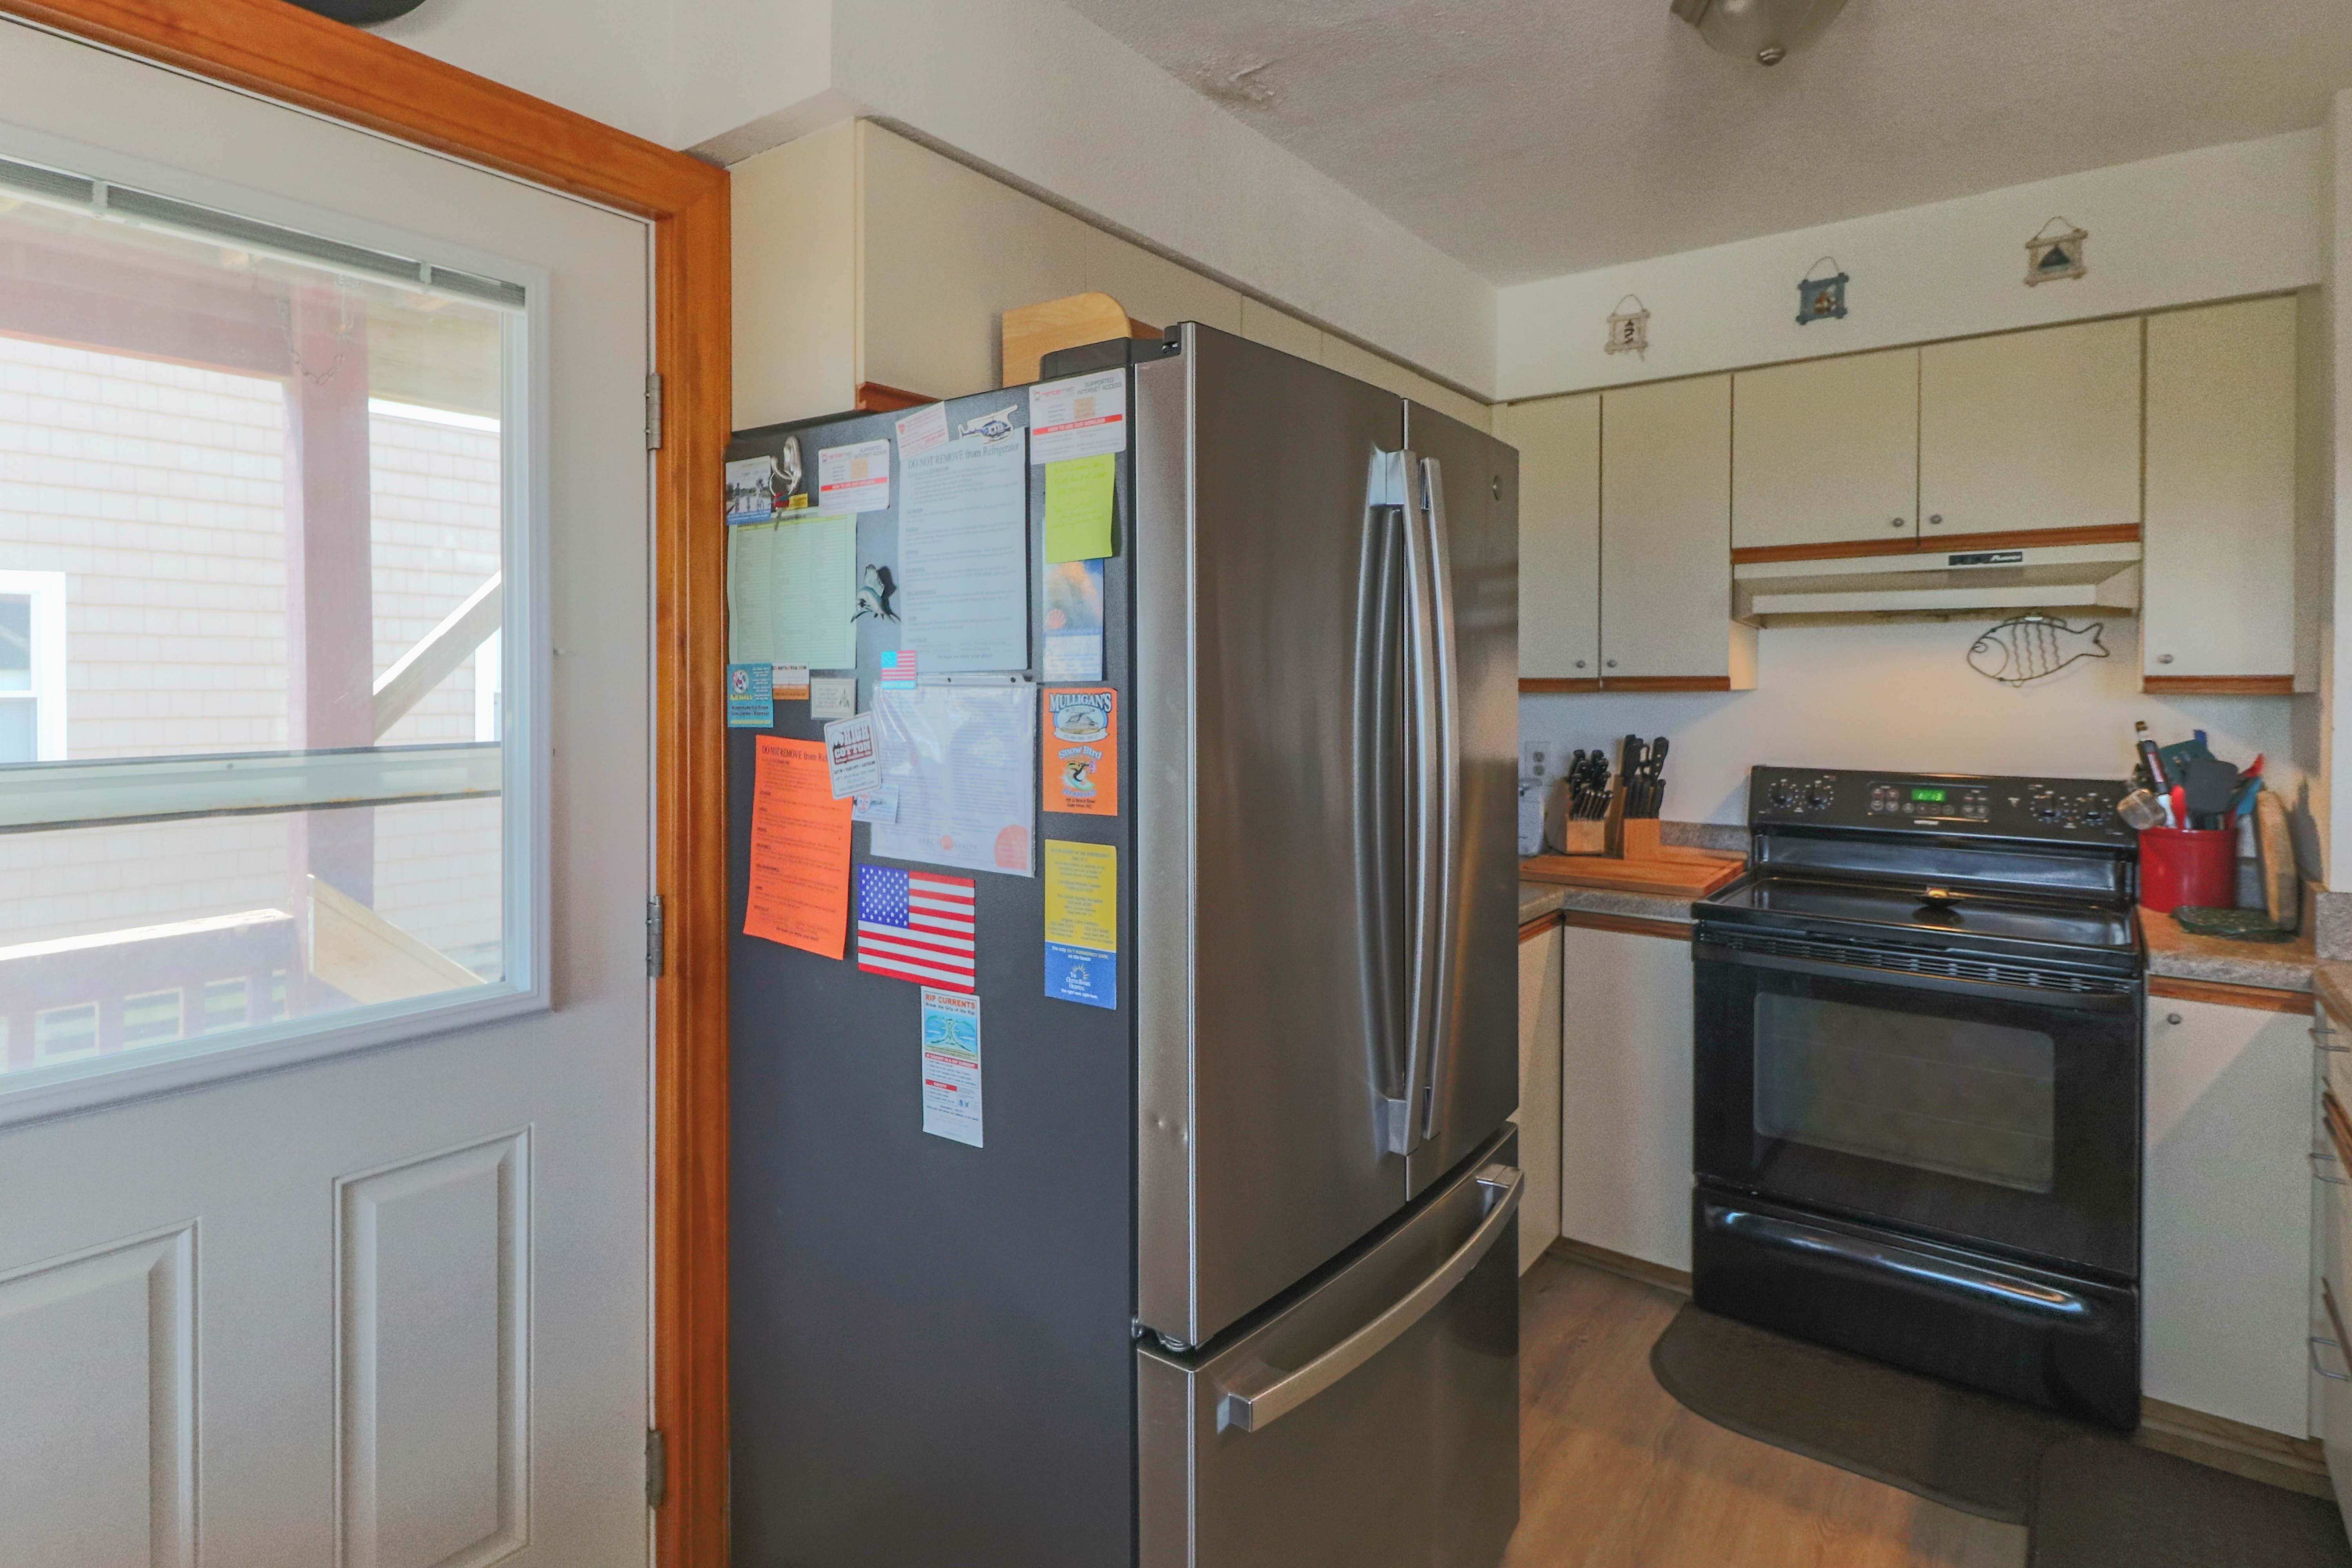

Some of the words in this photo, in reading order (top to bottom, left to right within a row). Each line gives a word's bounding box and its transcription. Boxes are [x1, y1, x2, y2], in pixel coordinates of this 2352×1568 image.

[1077, 386, 1102, 395] INTERNET
[1102, 382, 1122, 391] ACCESS
[1085, 377, 1114, 388] SUPPORTED
[908, 460, 918, 469] DO
[920, 456, 933, 466] NOT
[935, 450, 963, 465] REMOVE
[965, 448, 981, 458] from
[983, 443, 1019, 456] Refrigerator
[1049, 692, 1112, 713] MULLIGAN'S
[844, 725, 871, 746] HIGH
[762, 746, 769, 754] DO
[771, 746, 779, 756] NOT
[779, 748, 802, 759] REMOVE
[804, 752, 817, 760] from
[834, 740, 871, 759] COTTON
[1058, 746, 1081, 760] Snow
[1084, 746, 1103, 760] Bird
[938, 996, 975, 1009] CURRENTS
